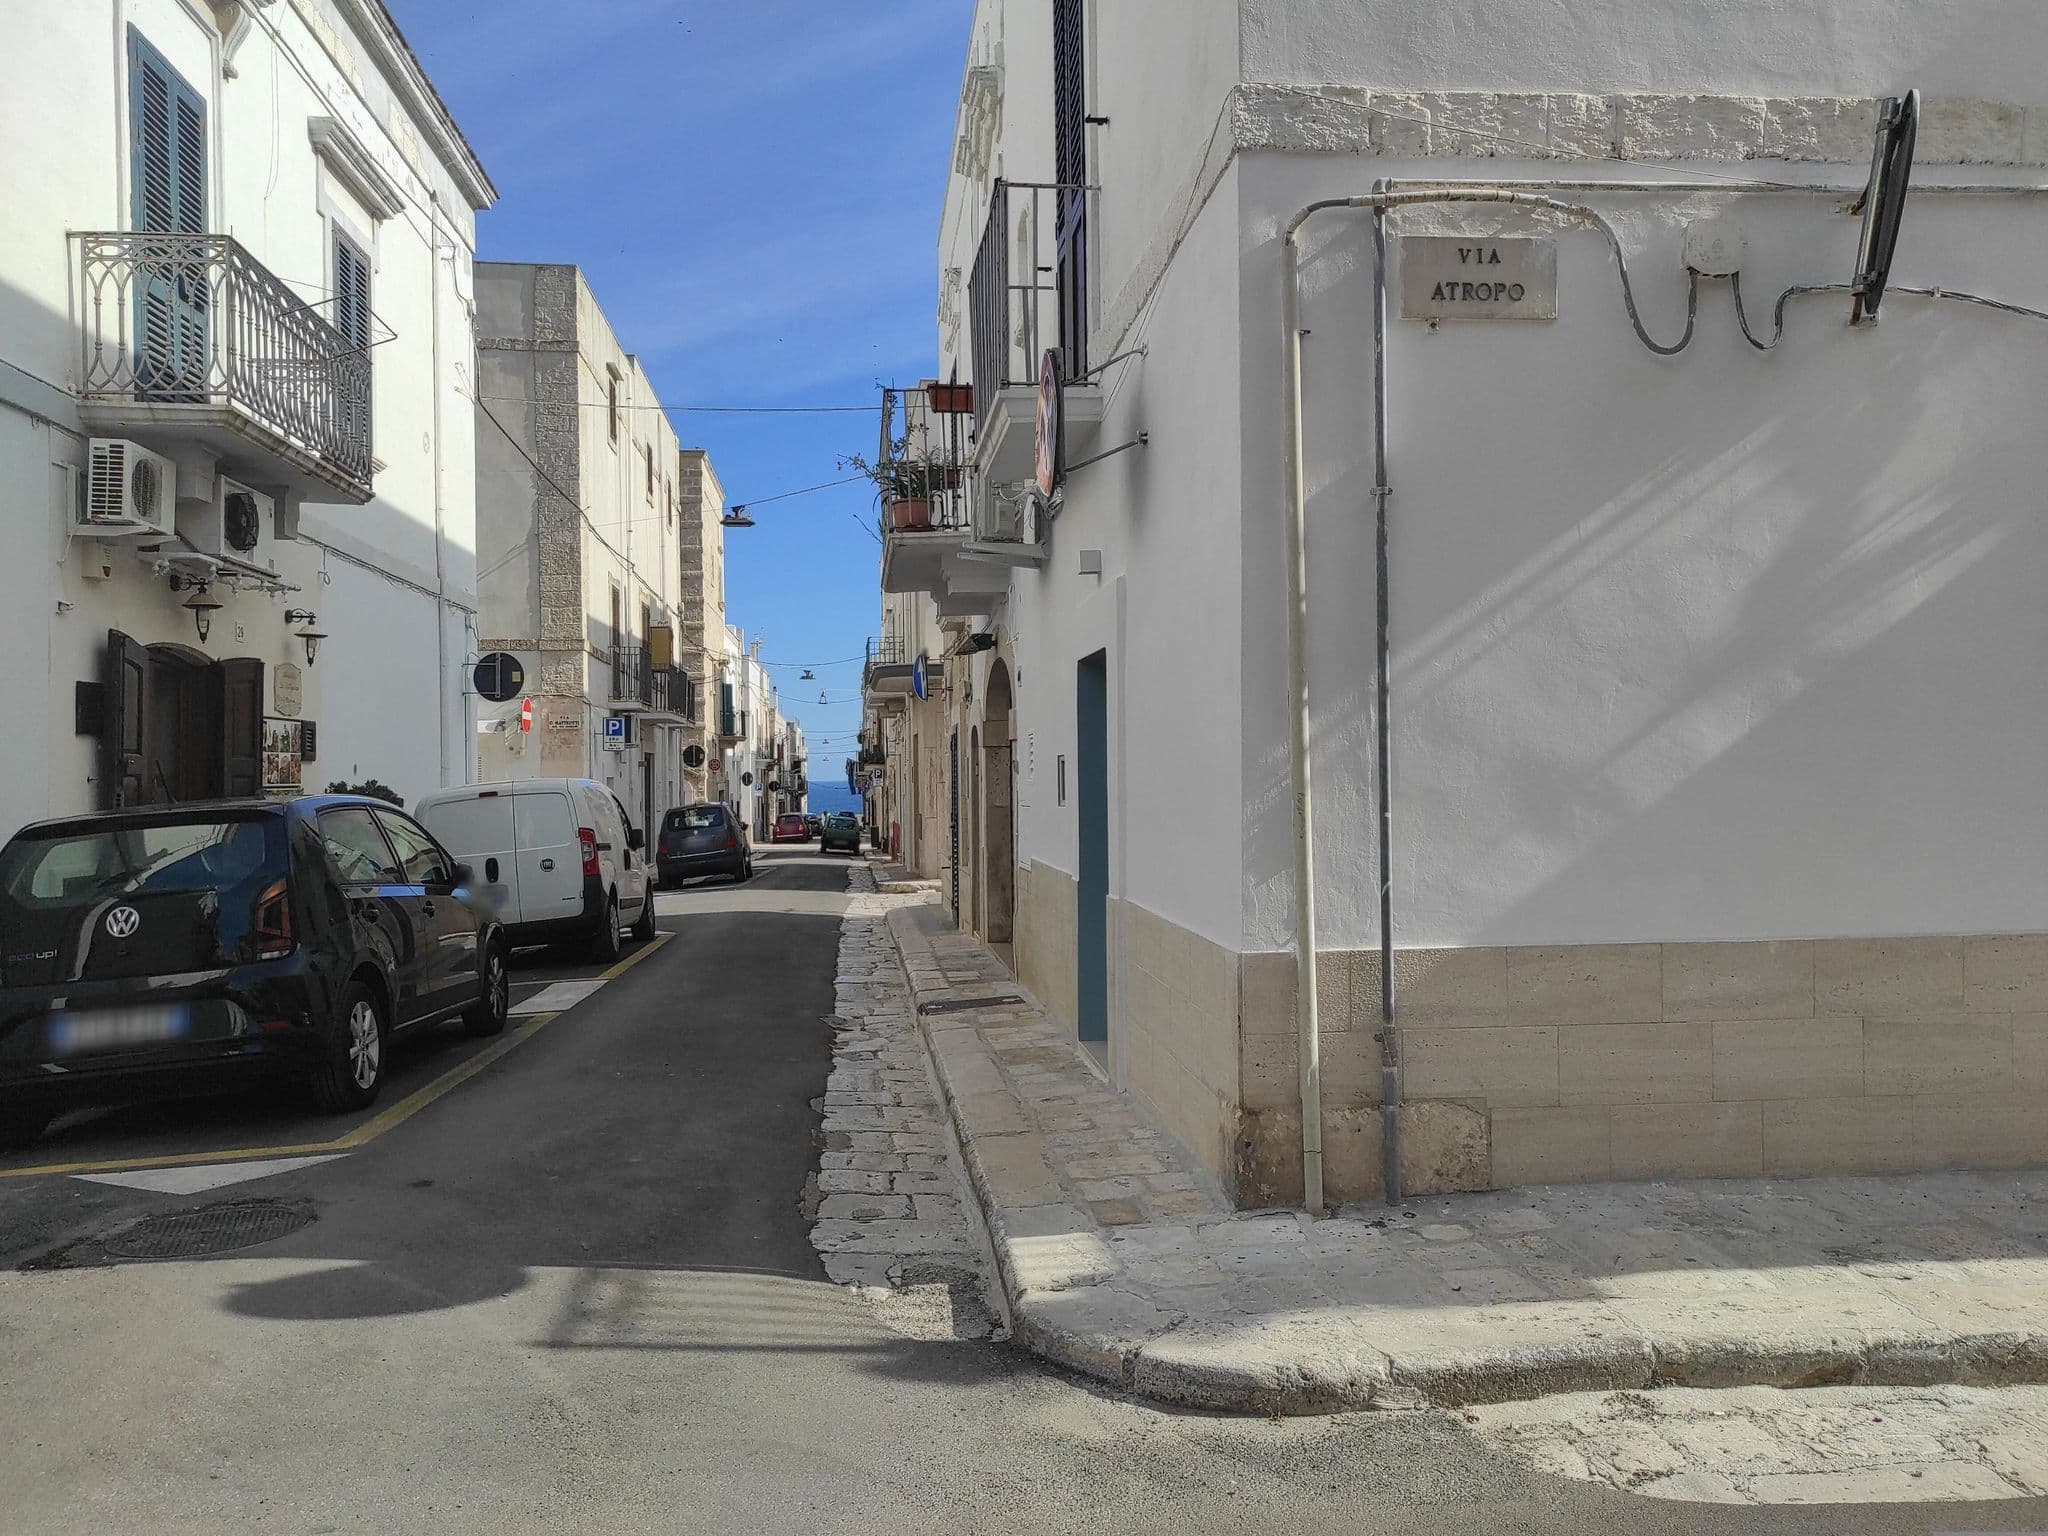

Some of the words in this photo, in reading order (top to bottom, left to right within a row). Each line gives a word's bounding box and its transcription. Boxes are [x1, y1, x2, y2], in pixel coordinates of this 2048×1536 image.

[1457, 247, 1501, 264] VIA
[1431, 281, 1526, 302] ATROPO
[608, 720, 620, 735] P
[875, 769, 882, 778] P
[36, 949, 58, 960] up!
